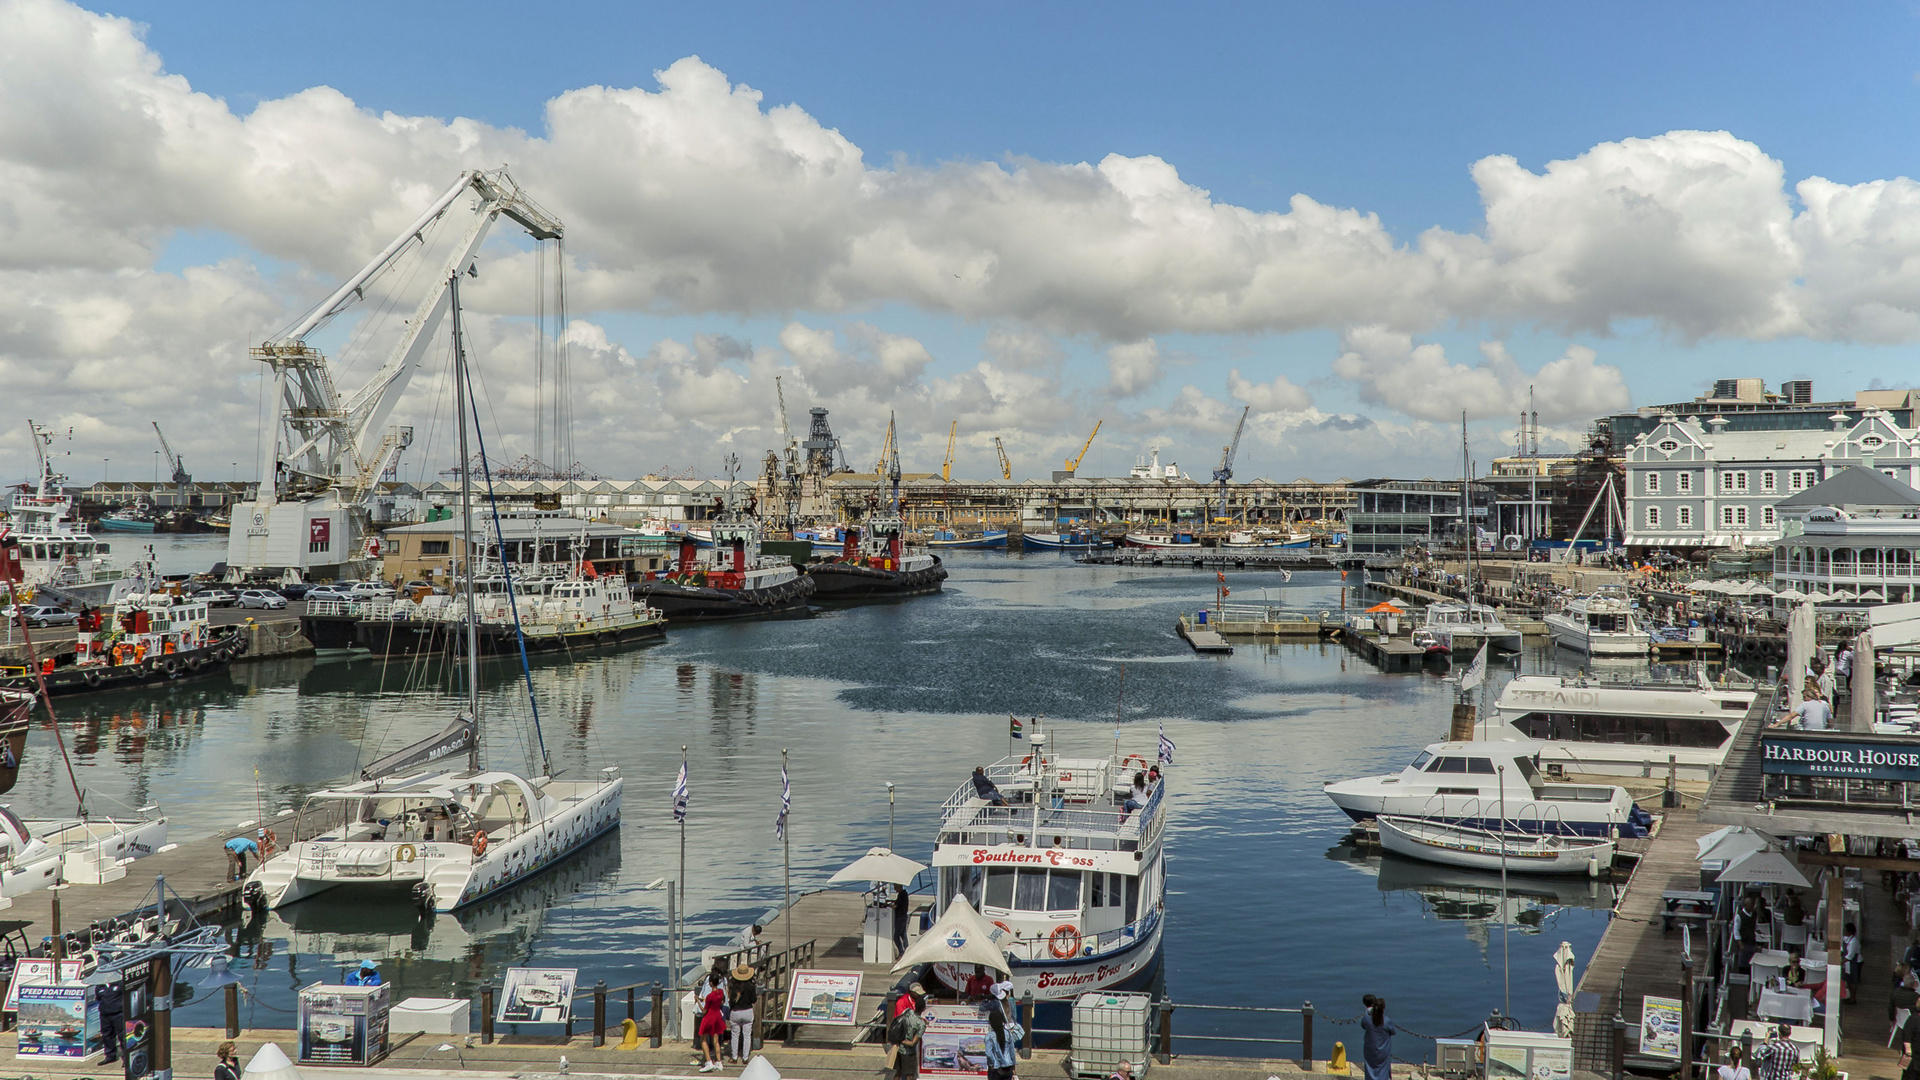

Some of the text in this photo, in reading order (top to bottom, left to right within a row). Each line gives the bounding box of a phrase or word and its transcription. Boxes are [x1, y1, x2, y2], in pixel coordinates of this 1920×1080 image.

[1764, 744, 1919, 767] HARBOUR HOUSE
[1810, 765, 1873, 773] RESTAURANT
[973, 849, 1042, 864] Southern
[125, 966, 150, 981] STORE
[1037, 971, 1095, 989] Southern
[1097, 964, 1121, 982] Cross
[1045, 988, 1060, 996] fun
